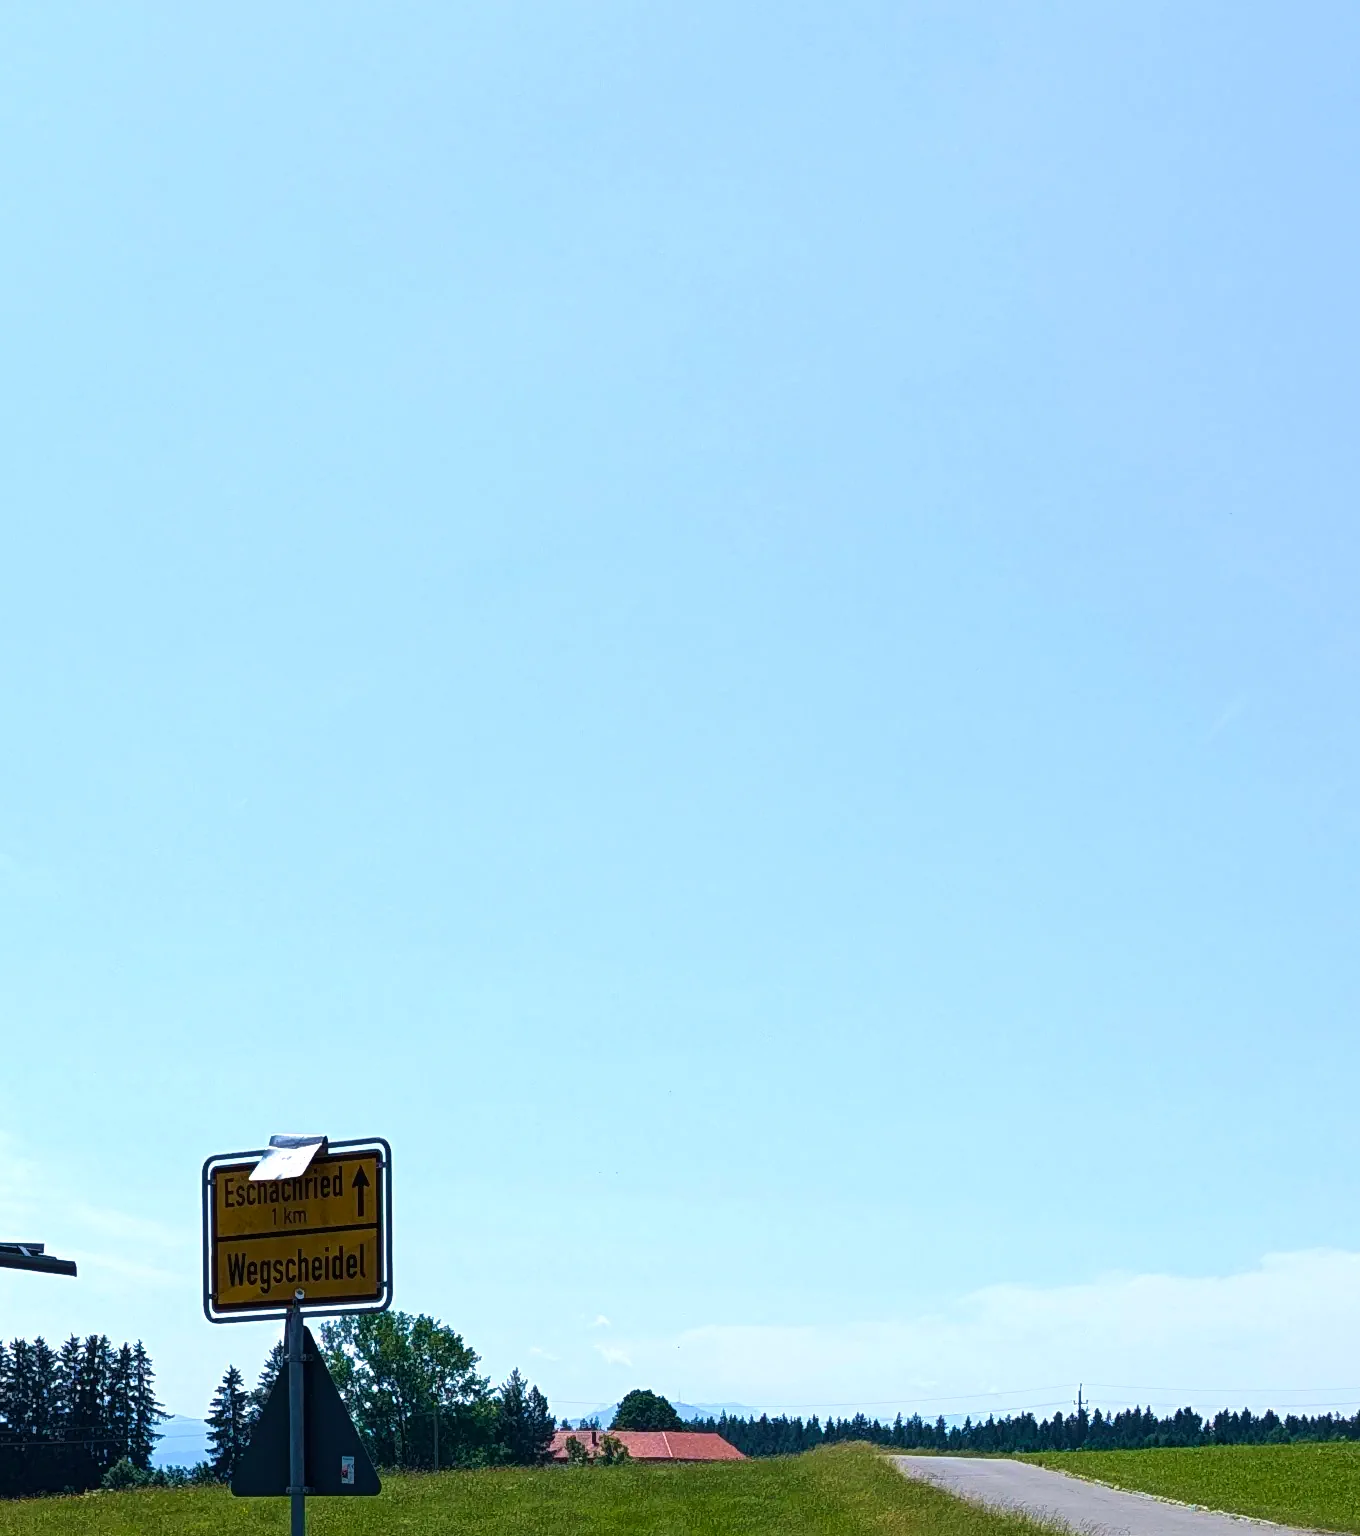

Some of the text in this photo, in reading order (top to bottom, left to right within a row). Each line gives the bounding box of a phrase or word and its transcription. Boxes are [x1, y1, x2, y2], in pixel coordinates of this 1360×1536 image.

[272, 1207, 307, 1225] 1 km
[227, 1244, 366, 1293] Wegscheidel
